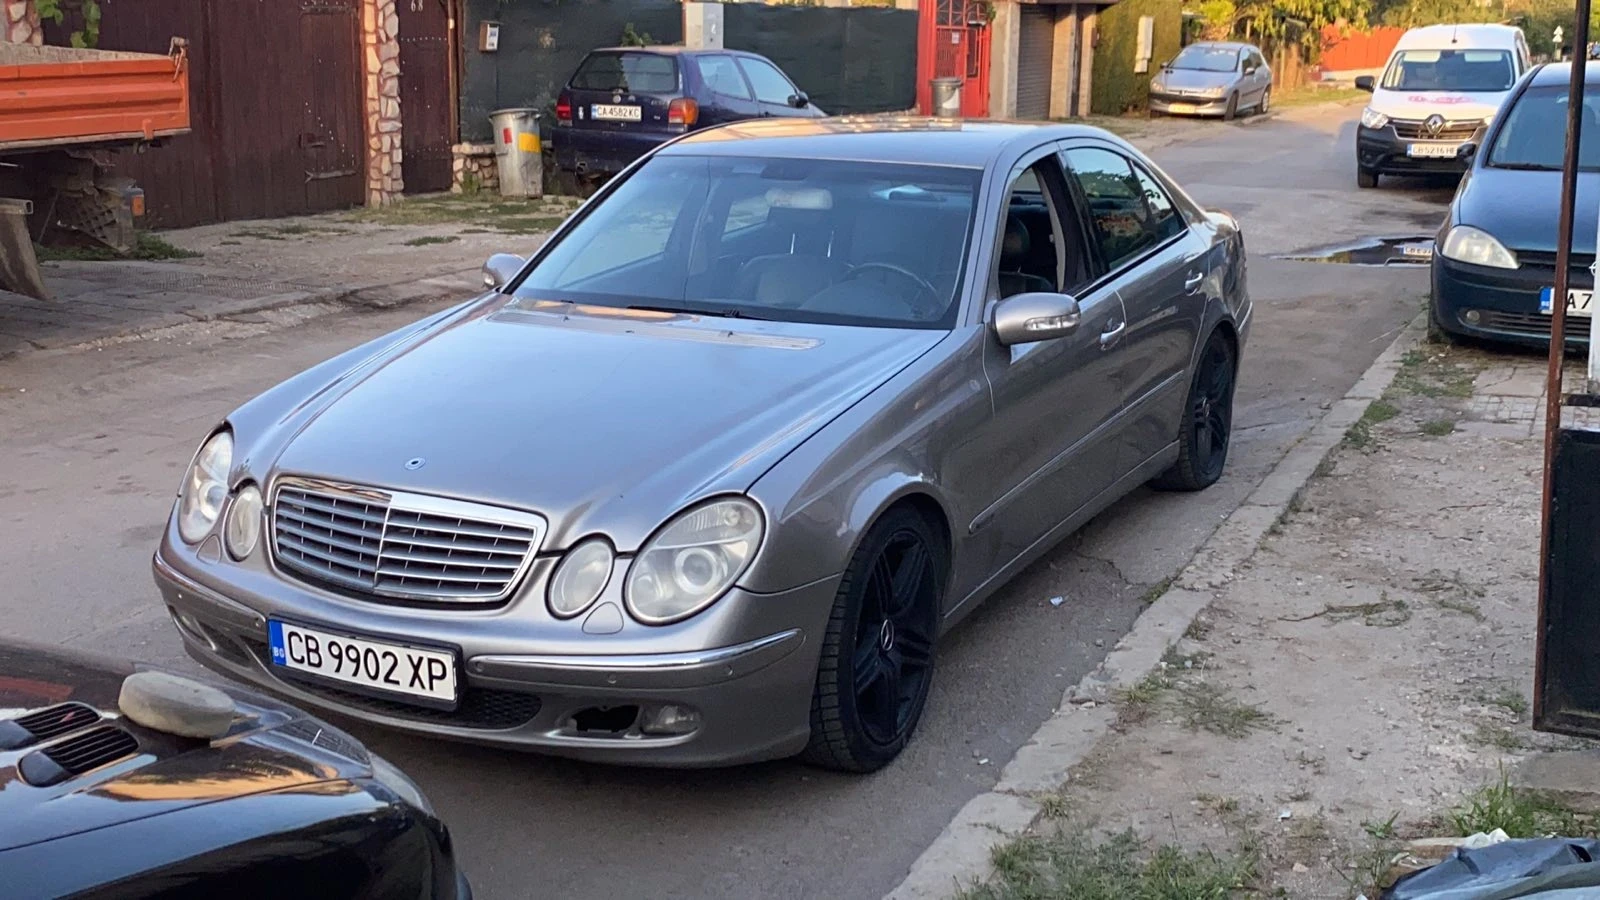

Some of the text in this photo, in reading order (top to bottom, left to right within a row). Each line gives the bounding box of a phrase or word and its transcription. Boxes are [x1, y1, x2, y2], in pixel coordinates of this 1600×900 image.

[410, 0, 424, 12] 68
[597, 107, 607, 116] CA
[287, 631, 447, 691] CB 9902 XP
